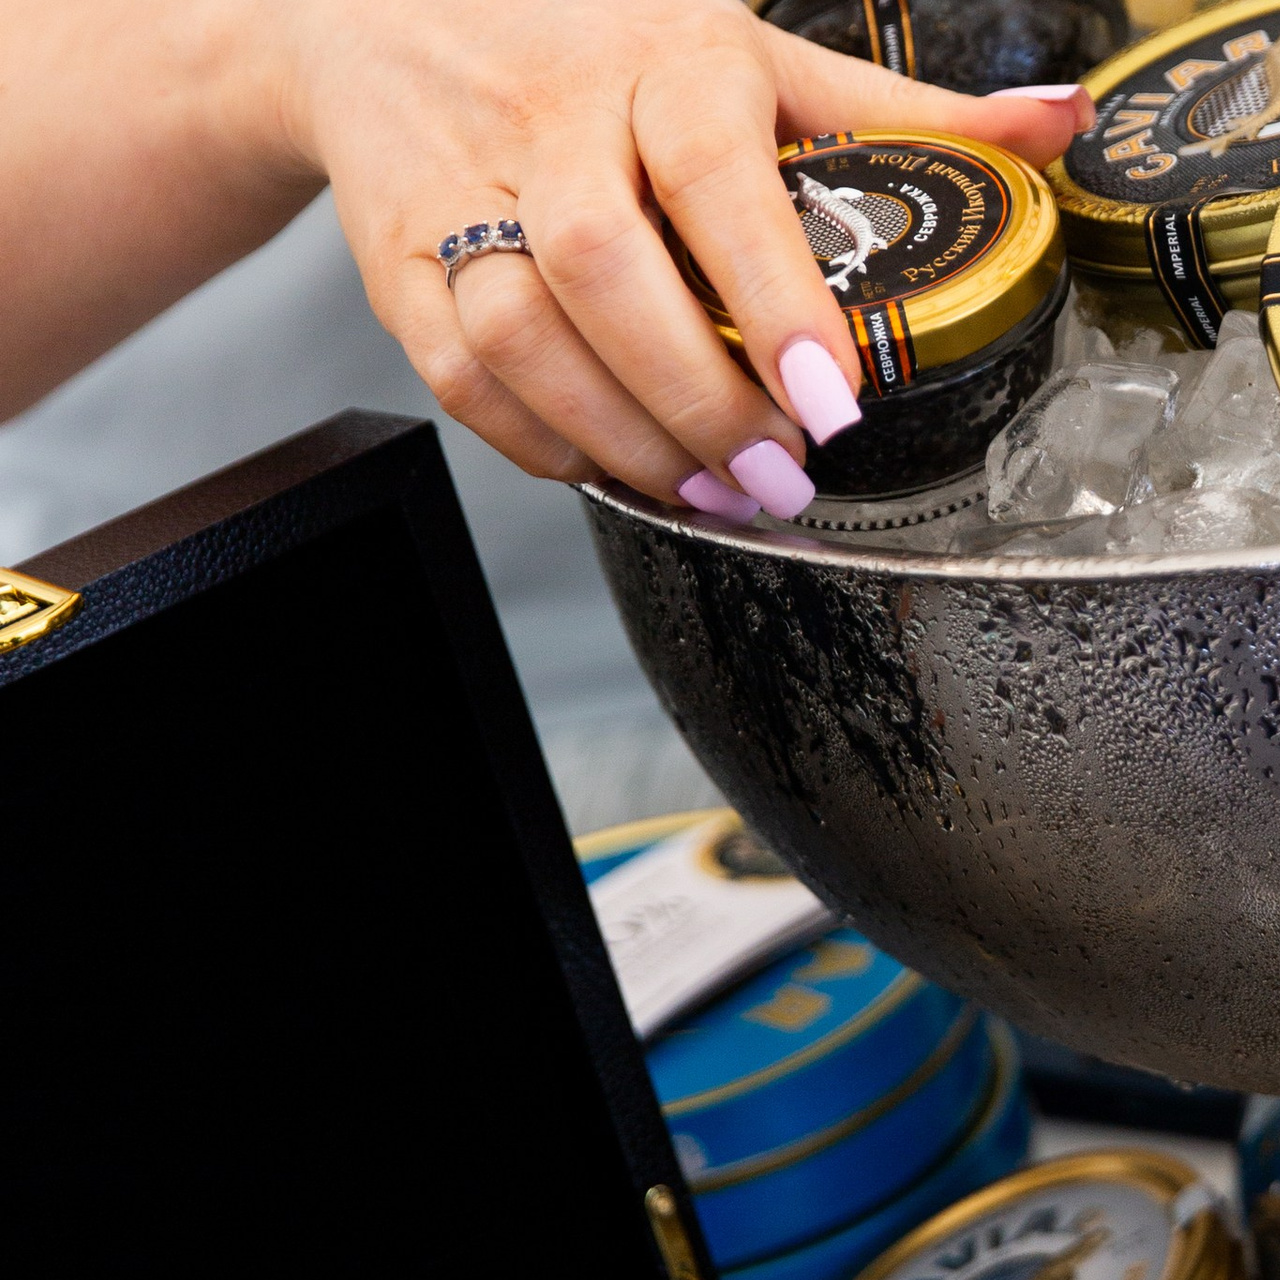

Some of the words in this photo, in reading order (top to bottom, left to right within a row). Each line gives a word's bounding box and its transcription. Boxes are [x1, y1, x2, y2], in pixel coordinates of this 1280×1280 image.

[1103, 29, 1273, 180] CAVIAR
[868, 152, 930, 172] Дом
[926, 160, 988, 222] Икорный
[900, 182, 939, 242] СЕВРЮЖКА
[901, 224, 983, 283] Русский
[1165, 213, 1186, 280] IMPERIAL
[869, 312, 896, 383] СЕВРЮЖКА
[1188, 295, 1218, 342] IMPERIAL
